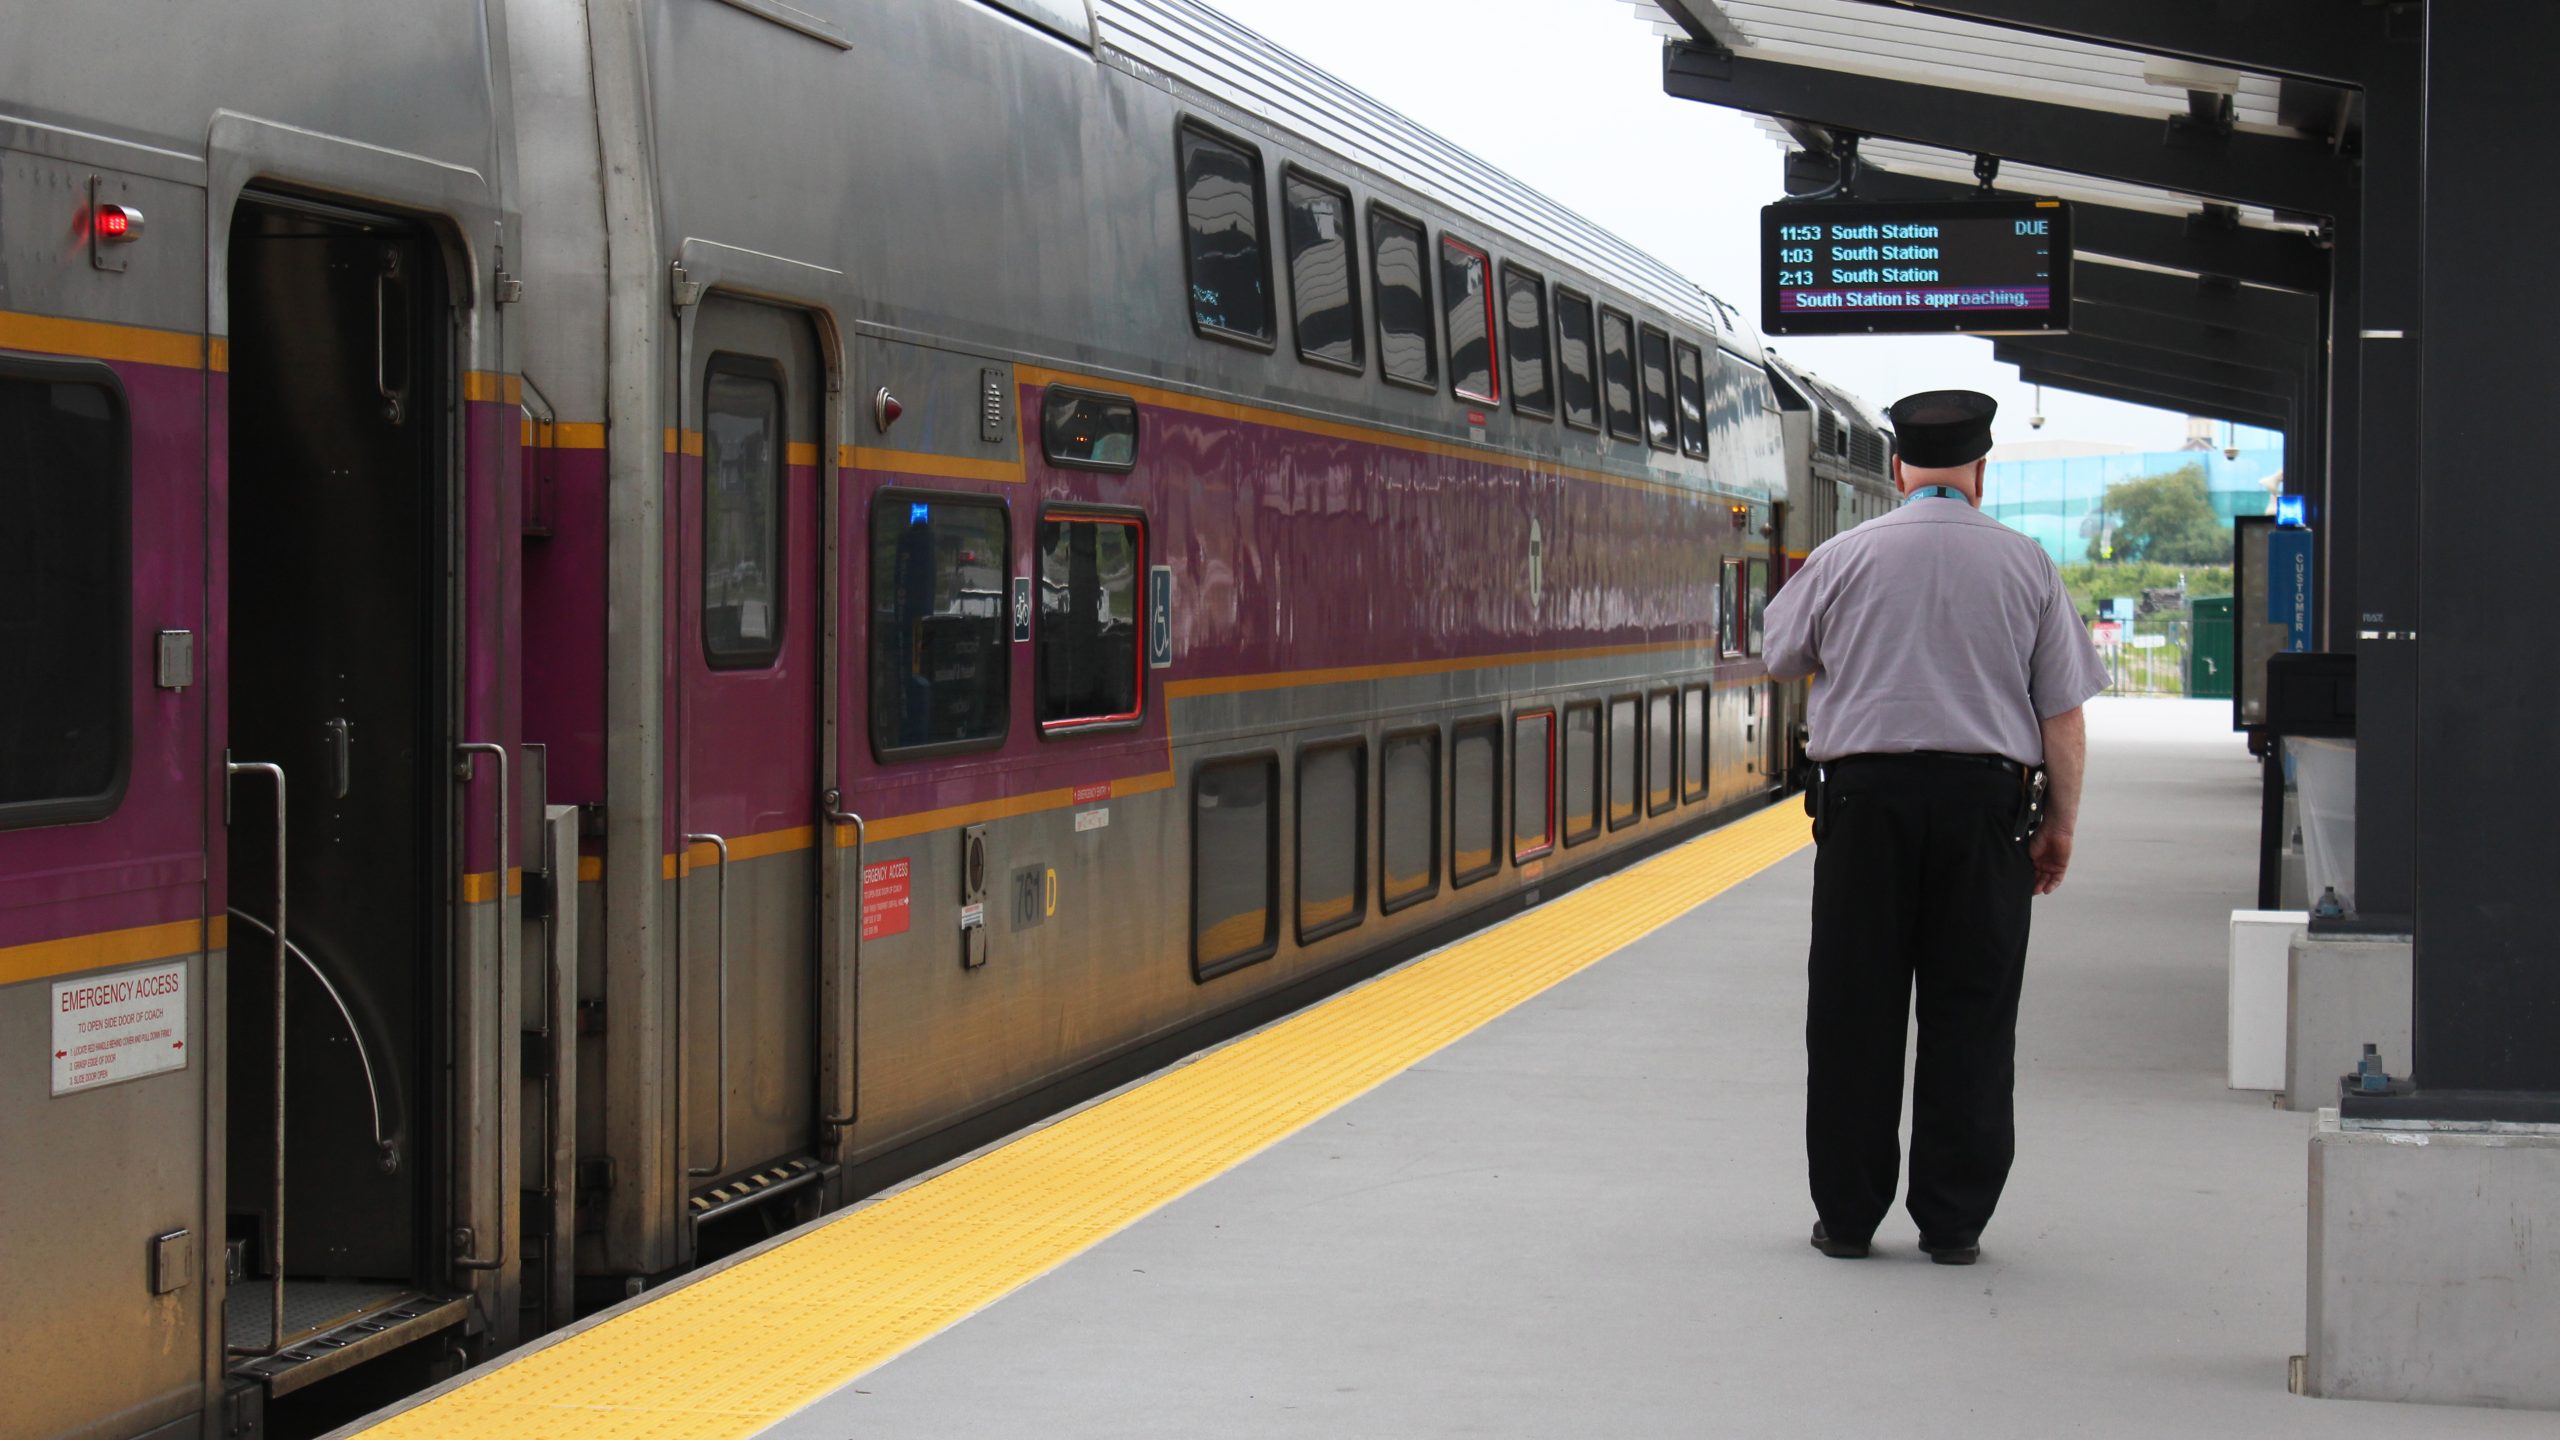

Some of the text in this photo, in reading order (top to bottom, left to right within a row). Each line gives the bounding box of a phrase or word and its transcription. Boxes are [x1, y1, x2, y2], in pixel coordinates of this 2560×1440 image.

[1780, 220, 2049, 241] 11:53 South Station DUE
[1780, 248, 1814, 263] 1:03
[1831, 246, 1878, 261] South
[1881, 244, 1939, 260] Station
[1779, 271, 1814, 286] 2:13
[1831, 268, 1878, 283] South
[1881, 267, 1939, 282] Station
[1796, 293, 1842, 307] South
[1846, 292, 1902, 306] Station
[1905, 291, 1921, 305] is
[2295, 553, 2305, 632] CUSTOMER
[863, 862, 908, 885] ERGENCY ACCESS
[1015, 871, 1041, 924] 761
[62, 973, 179, 1013] EMERGENCY ACCESS
[78, 1008, 164, 1033] TO OPEN SIDE DOOR OF COACH
